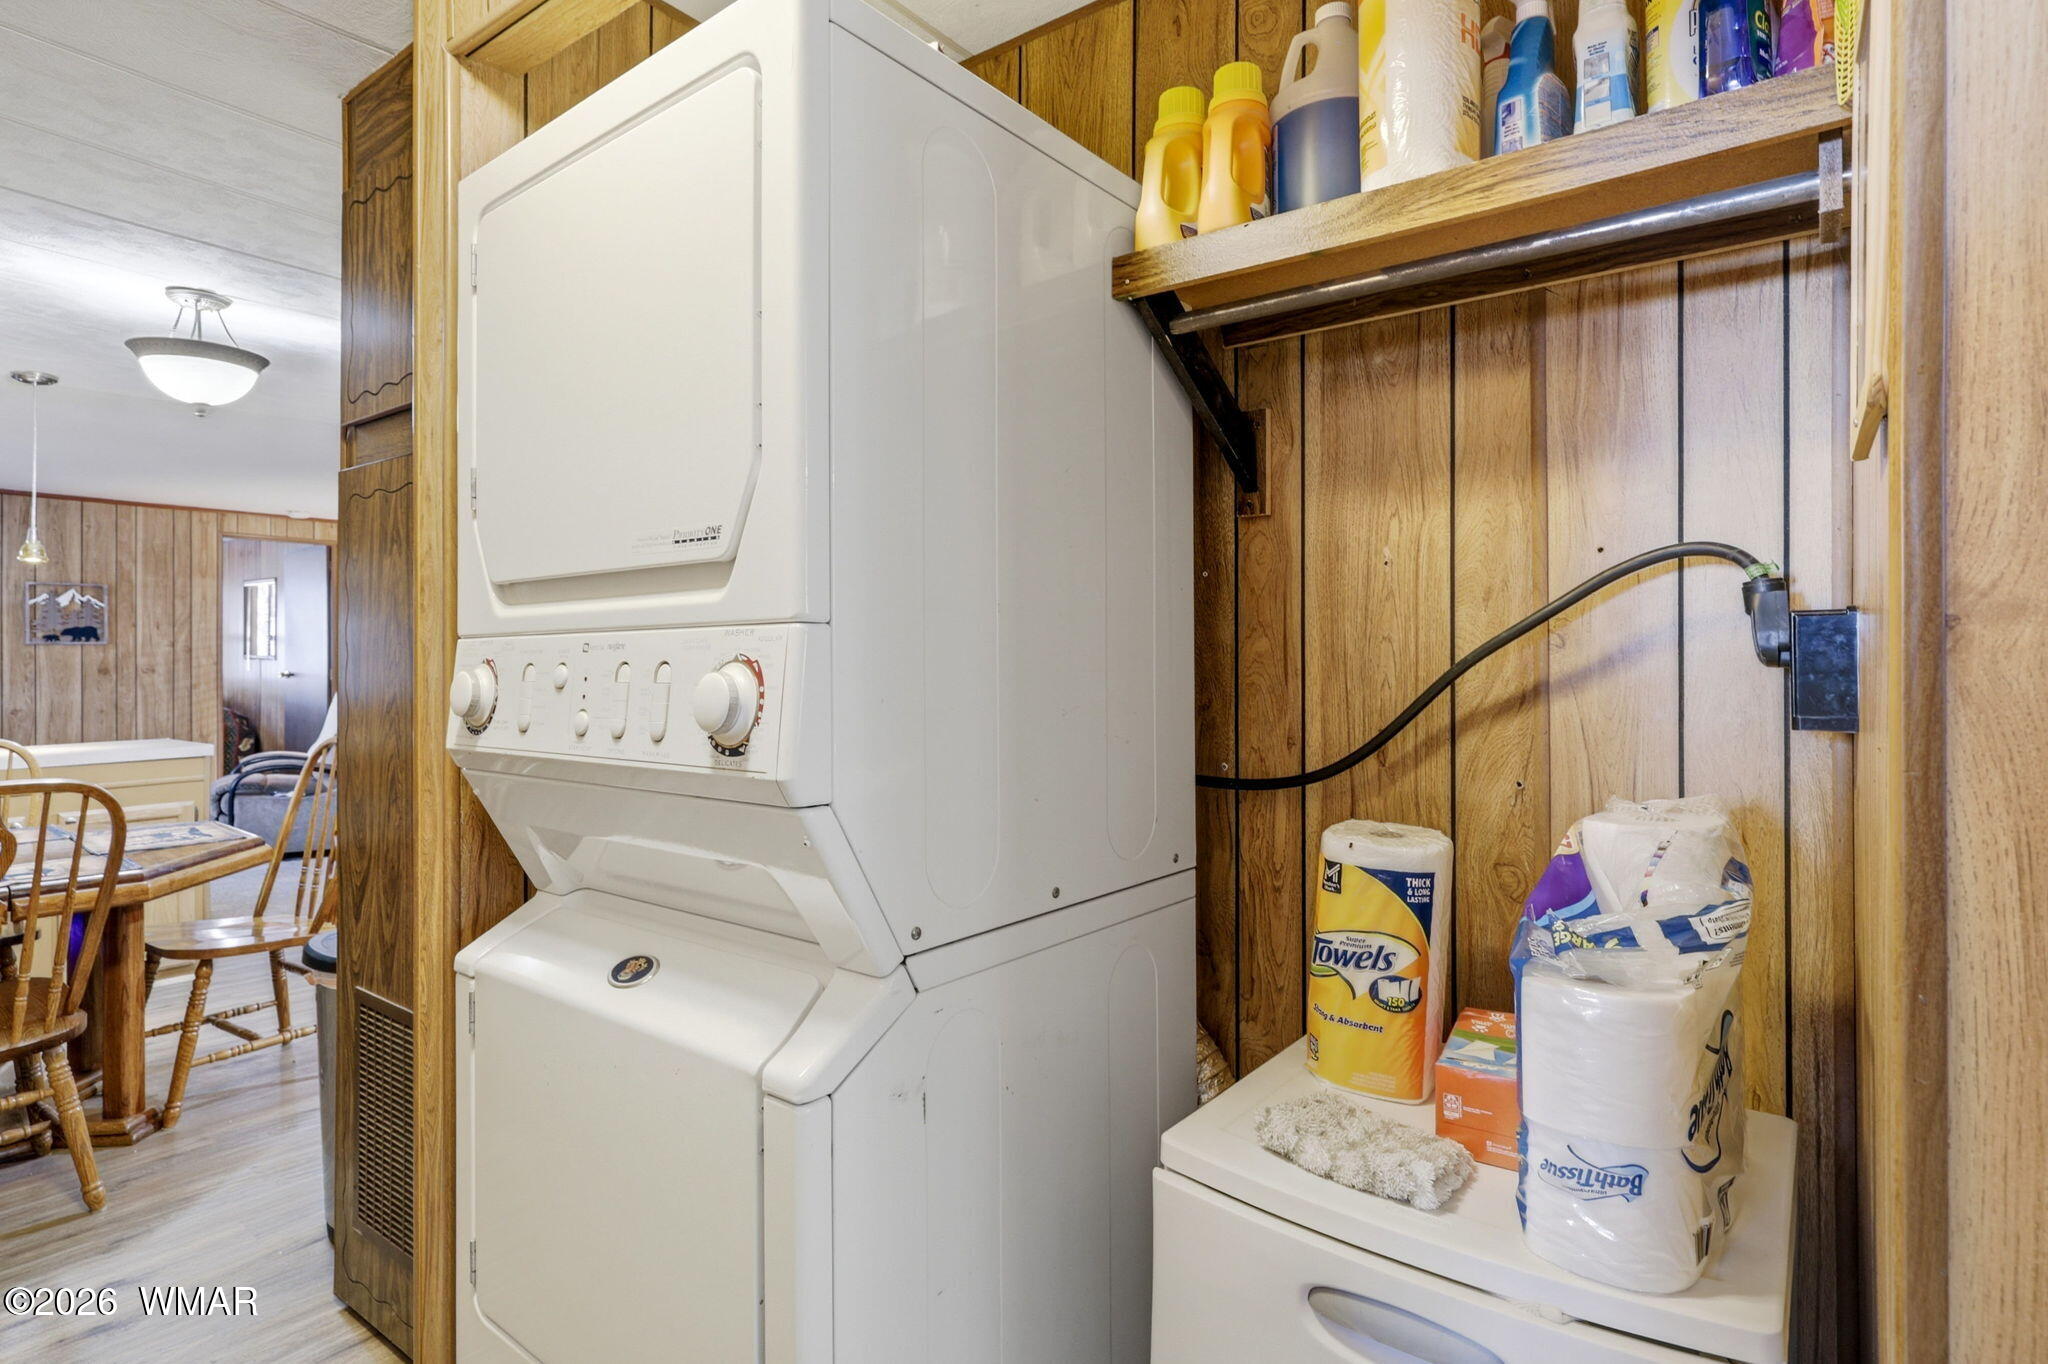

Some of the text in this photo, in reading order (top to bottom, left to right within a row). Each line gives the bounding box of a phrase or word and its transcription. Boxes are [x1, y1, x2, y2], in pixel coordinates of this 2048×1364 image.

[1405, 877, 1431, 888] THICK
[1414, 888, 1431, 896] LONG
[1339, 940, 1373, 949] Premium
[1312, 936, 1397, 972] Towels
[1386, 996, 1406, 1008] 150
[1337, 1016, 1384, 1033] Absorbent
